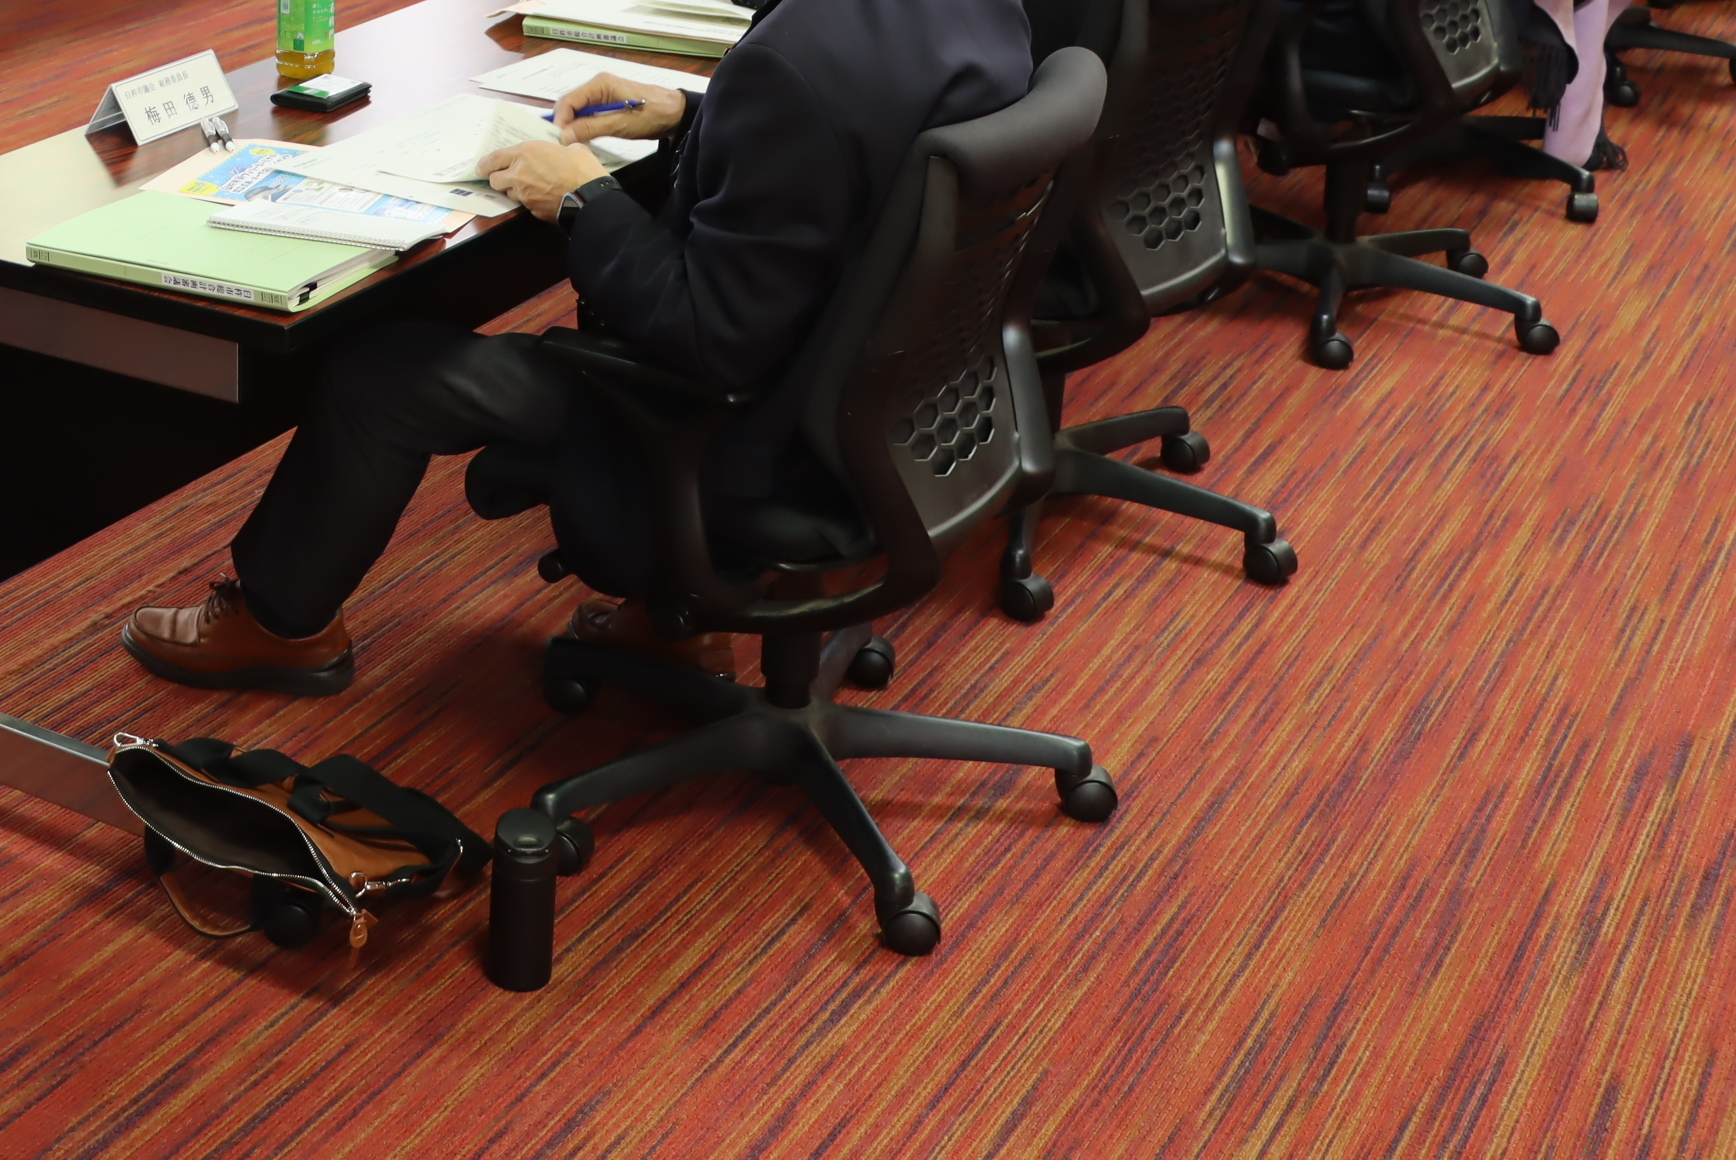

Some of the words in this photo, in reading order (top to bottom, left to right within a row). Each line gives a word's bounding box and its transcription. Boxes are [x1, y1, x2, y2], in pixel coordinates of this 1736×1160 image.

[124, 82, 156, 100] 臼杵市議会
[144, 100, 178, 125] 梅田
